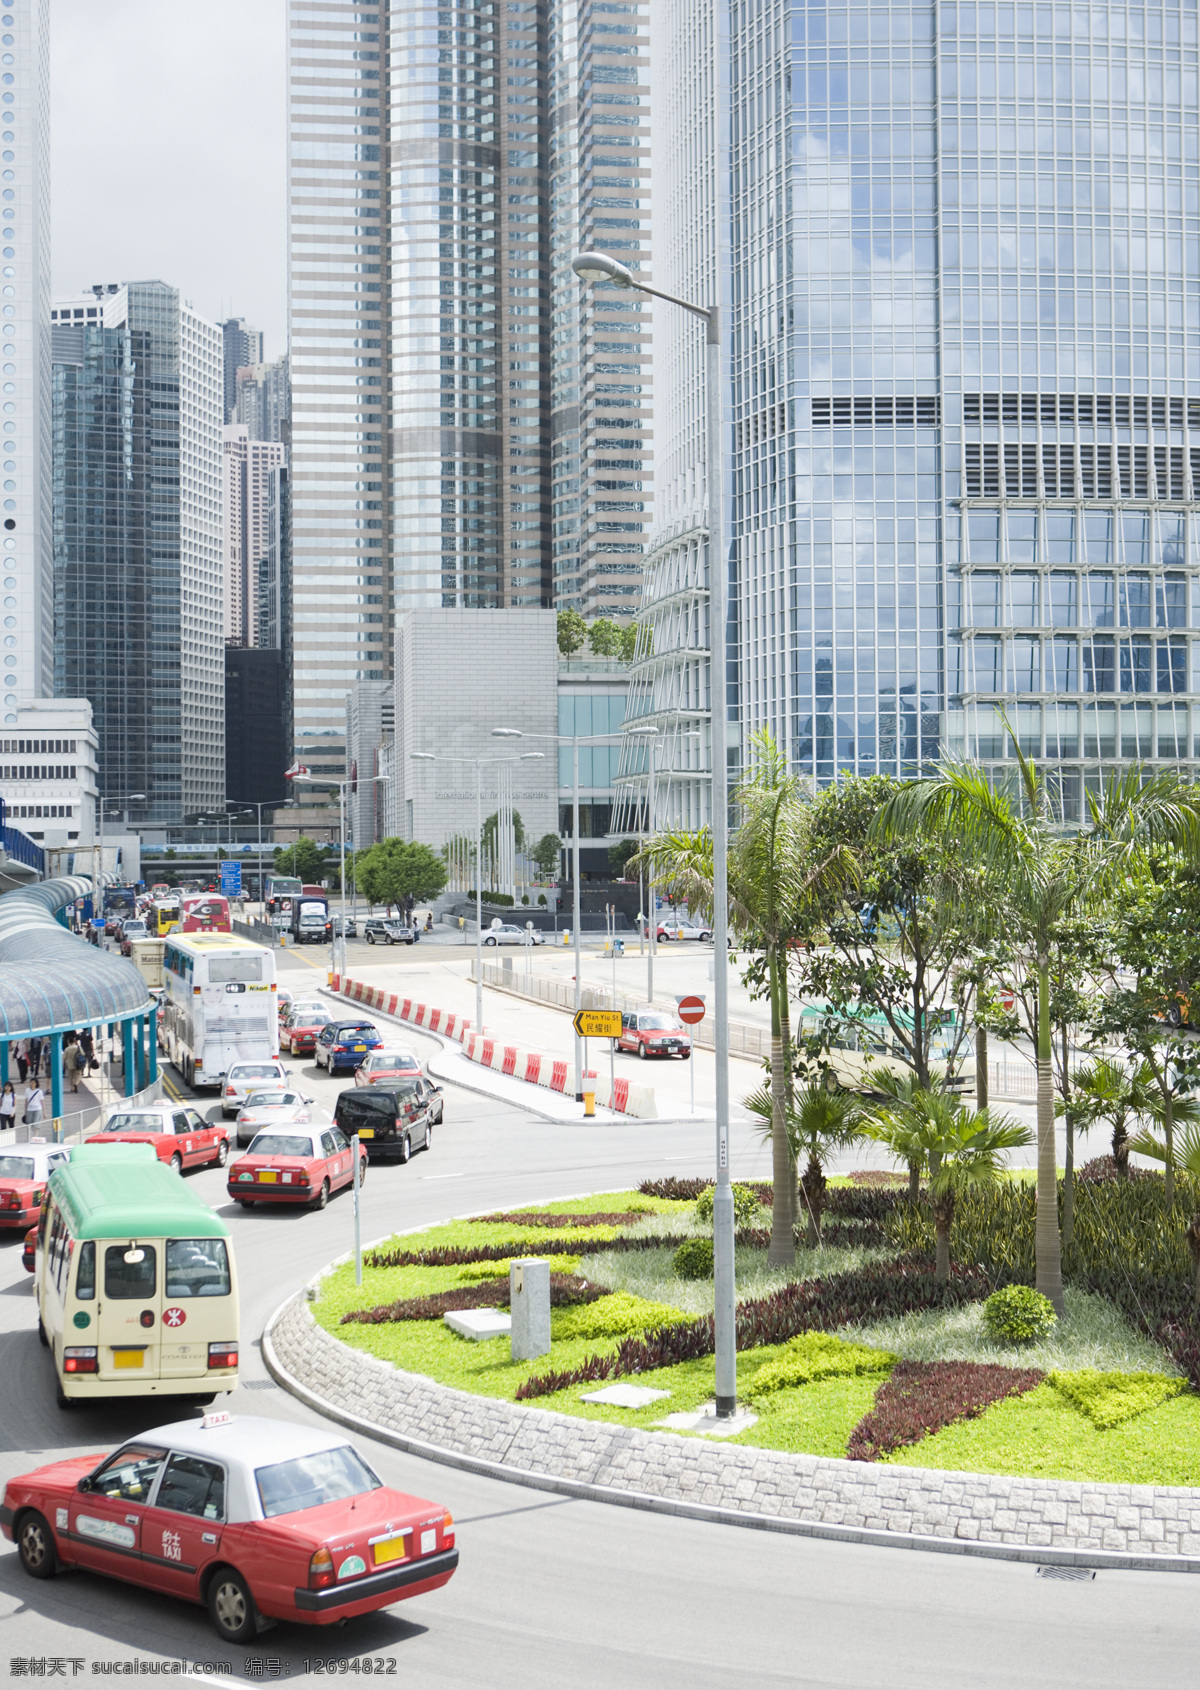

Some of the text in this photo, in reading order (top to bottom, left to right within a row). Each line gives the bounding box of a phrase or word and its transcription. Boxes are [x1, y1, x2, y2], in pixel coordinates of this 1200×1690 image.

[586, 1023, 612, 1033] 民耀街
[209, 1415, 230, 1425] TAXI
[162, 1530, 181, 1545] 的士
[162, 1545, 182, 1561] TAXI
